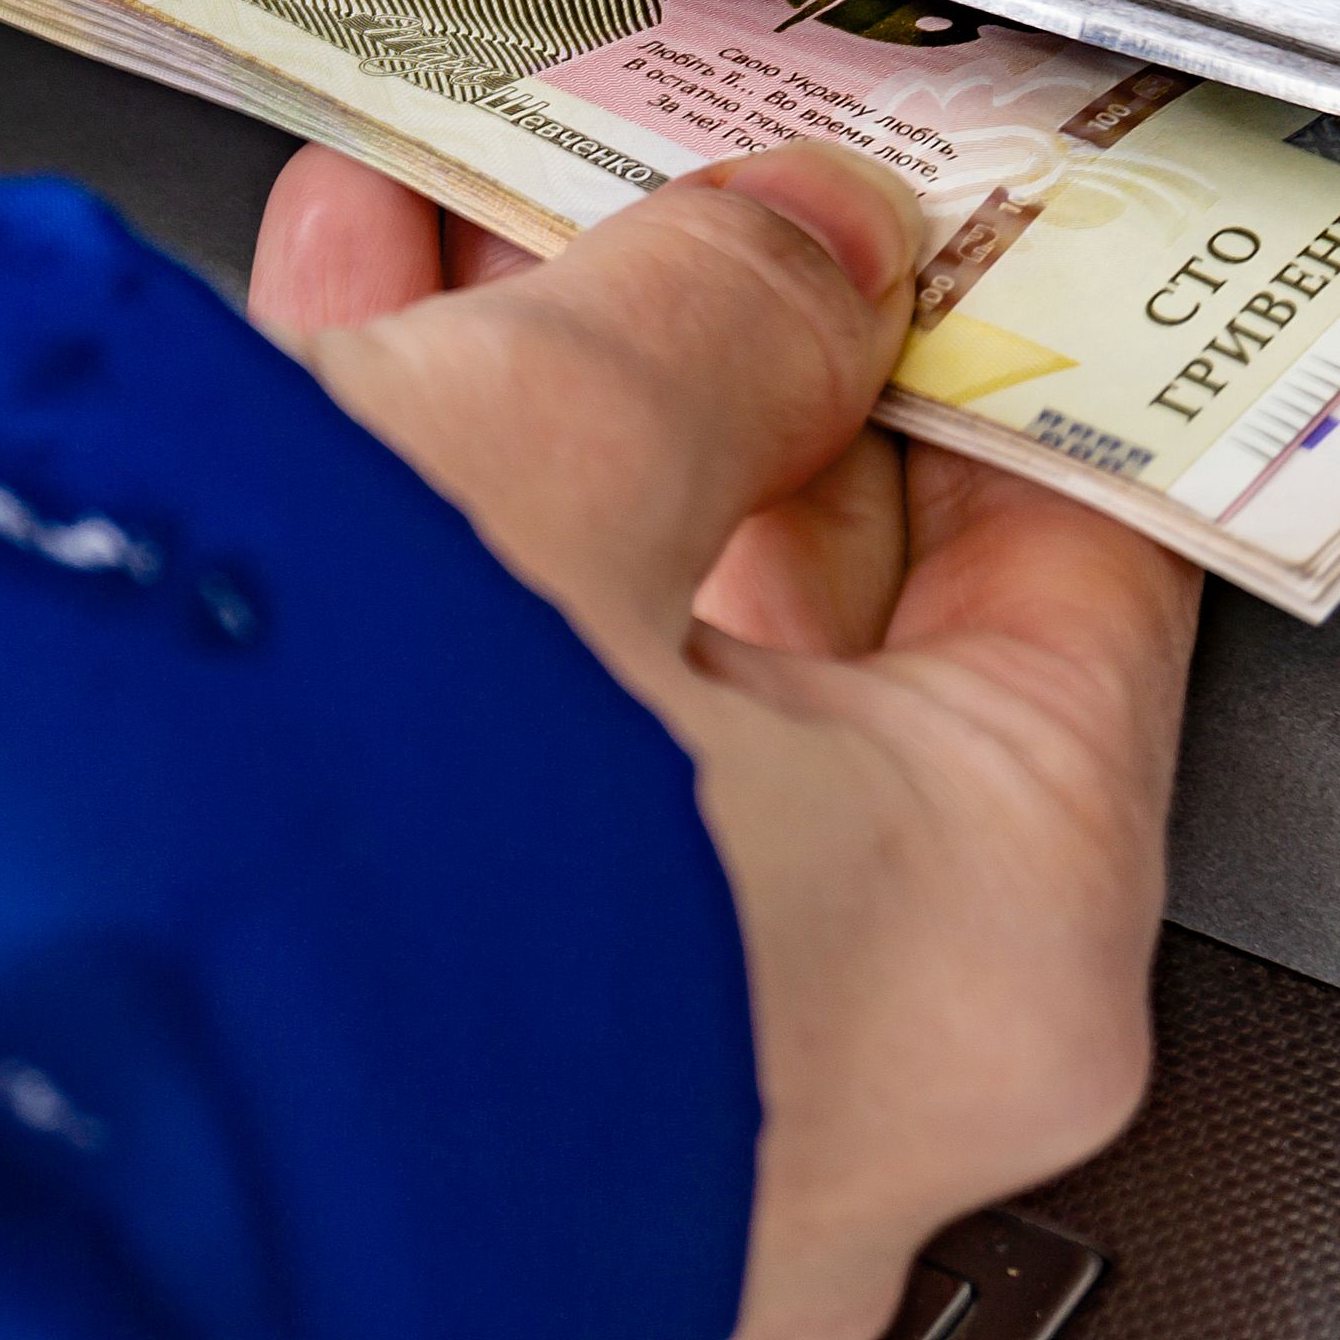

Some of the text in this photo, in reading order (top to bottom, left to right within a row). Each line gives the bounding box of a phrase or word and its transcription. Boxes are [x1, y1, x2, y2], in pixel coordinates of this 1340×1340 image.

[474, 85, 653, 184] Шевченко
[623, 57, 807, 141] В остатню тяжк
[637, 39, 716, 77] Любіть
[764, 90, 798, 111] Во
[799, 108, 875, 148] время
[873, 145, 939, 183] люте,
[646, 92, 767, 153] За неї Гос
[717, 46, 958, 161] Свою Україну любіть,
[1087, 103, 1132, 132] 100
[1144, 225, 1261, 328] СТО
